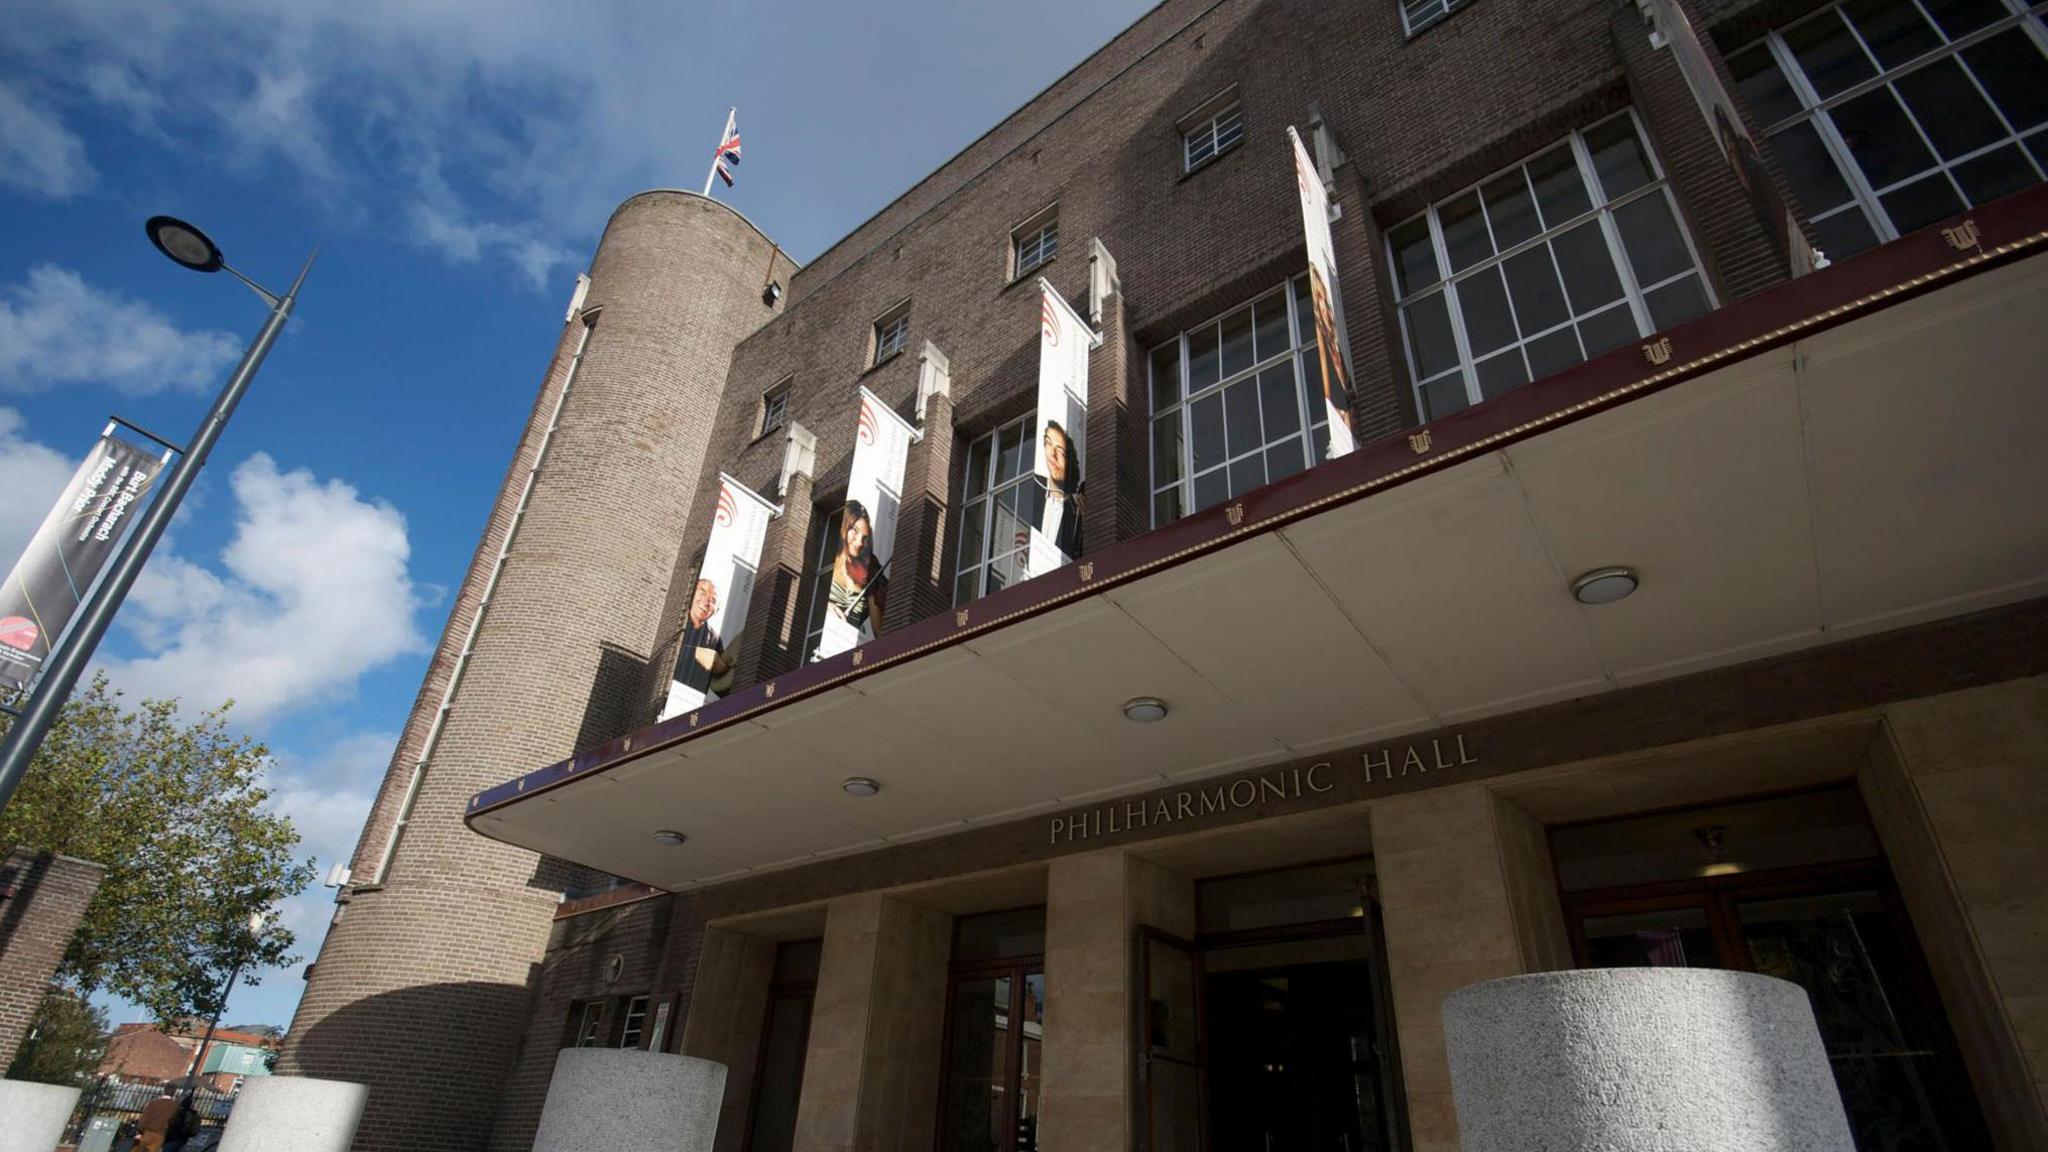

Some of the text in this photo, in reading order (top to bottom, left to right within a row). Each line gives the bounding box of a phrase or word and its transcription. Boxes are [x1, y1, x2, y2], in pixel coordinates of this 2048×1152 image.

[73, 456, 116, 512] Maddy Prior
[95, 471, 147, 541] Burt Bacharach
[1049, 734, 1478, 843] PHILHARMONIC HALL
